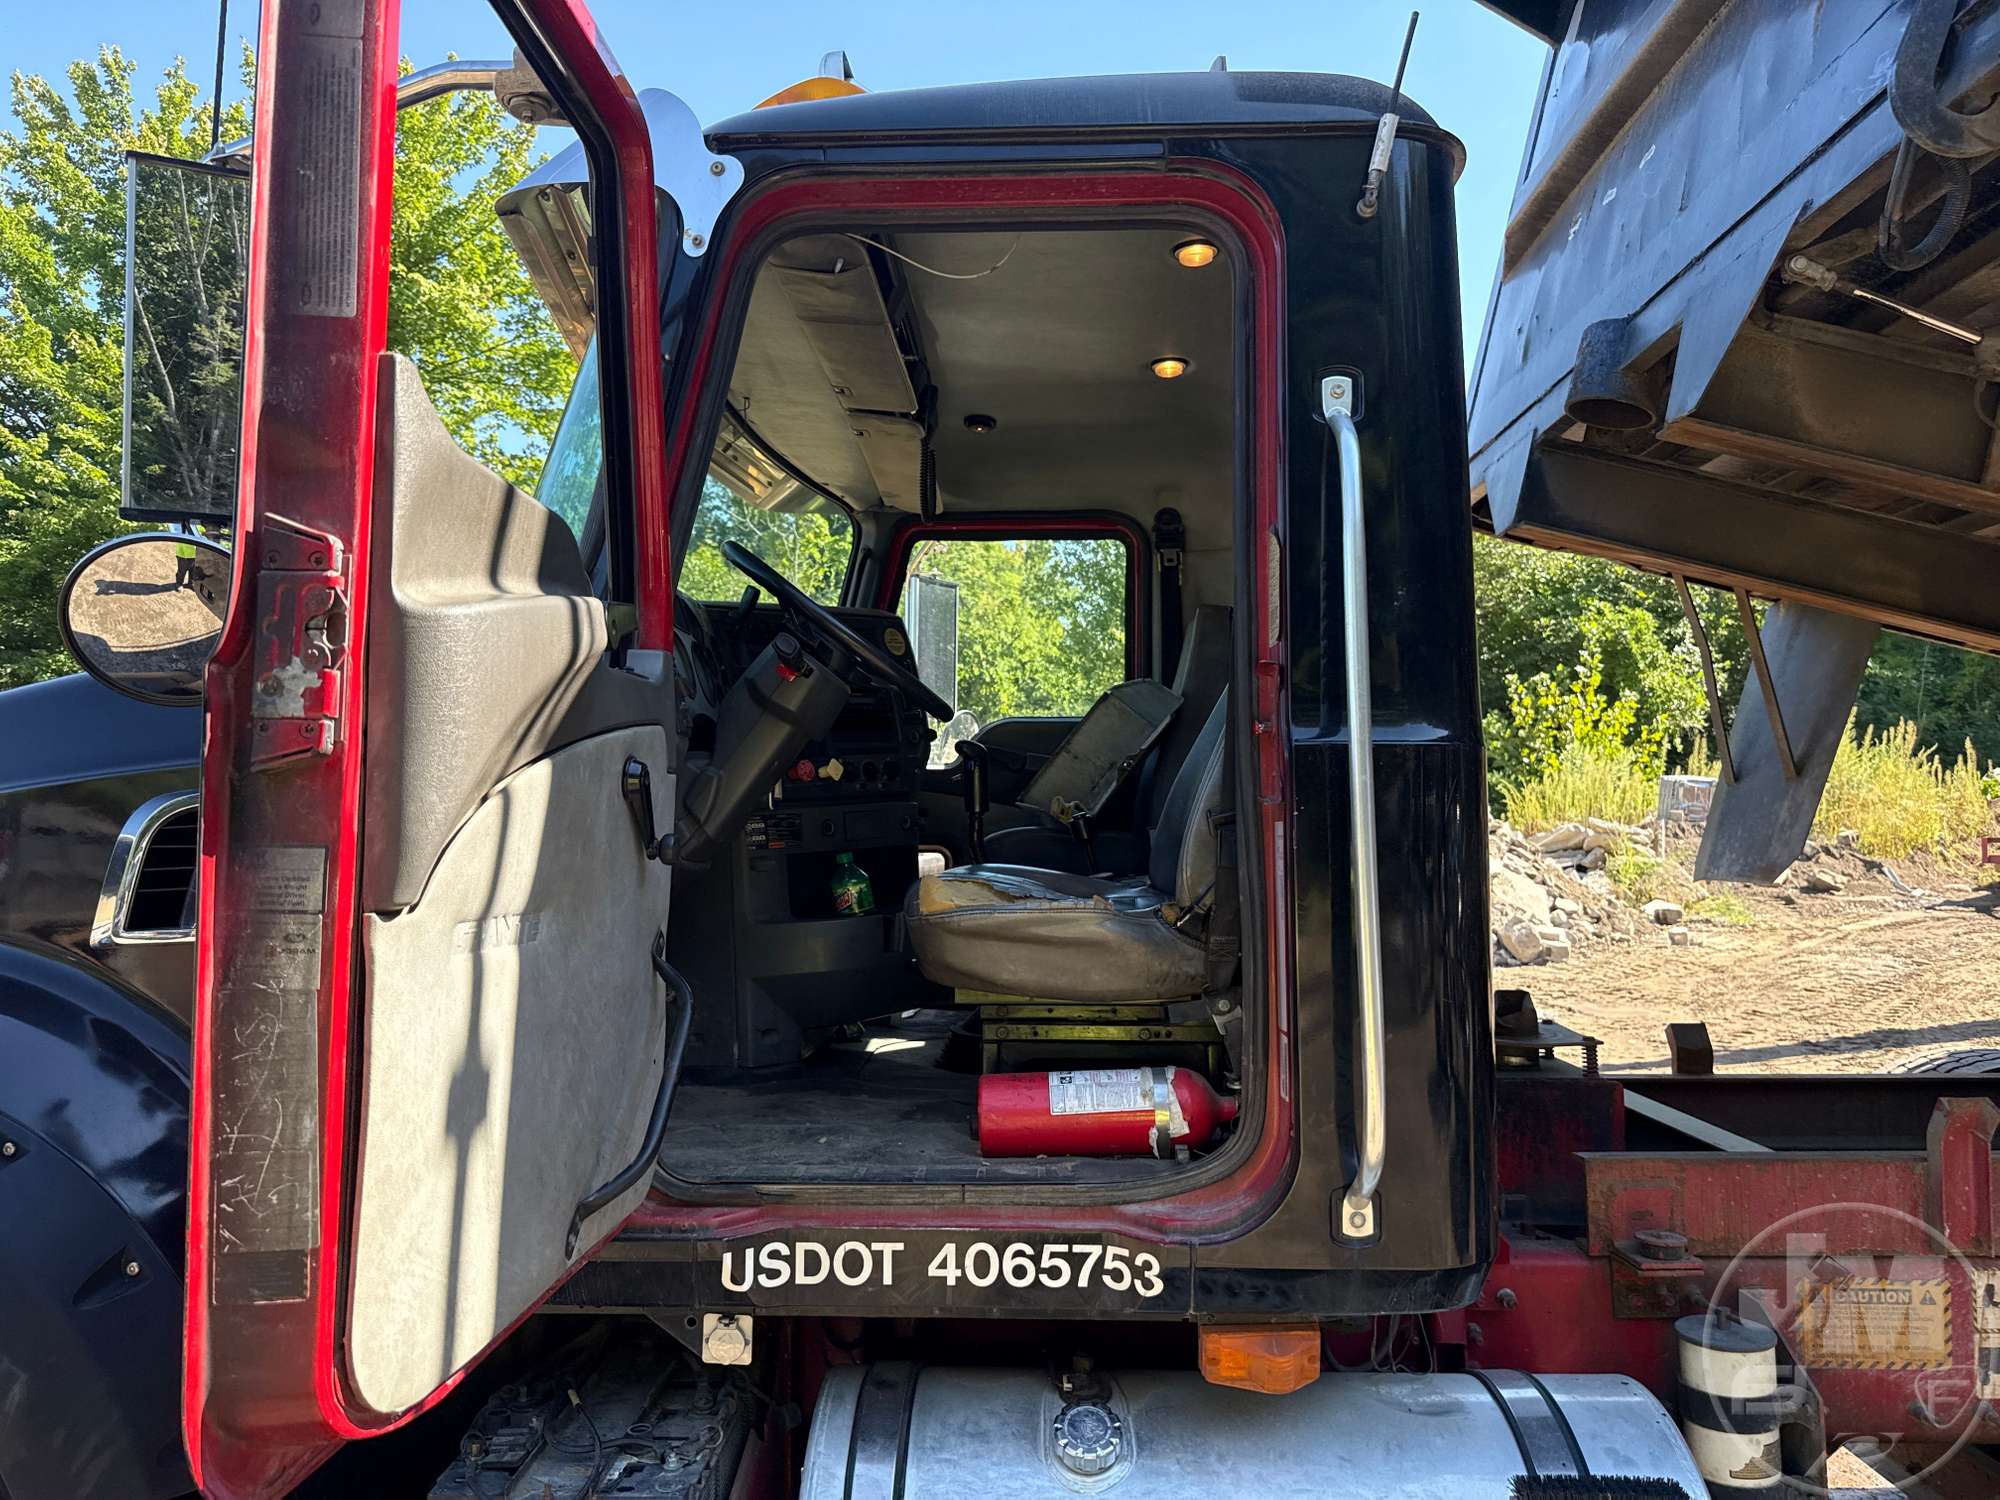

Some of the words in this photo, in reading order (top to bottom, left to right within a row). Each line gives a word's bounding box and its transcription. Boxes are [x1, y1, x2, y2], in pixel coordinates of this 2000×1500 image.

[721, 1241, 905, 1292] USDOT
[927, 1242, 1165, 1297] 4065753
[1834, 1289, 1910, 1304] CAUTION
